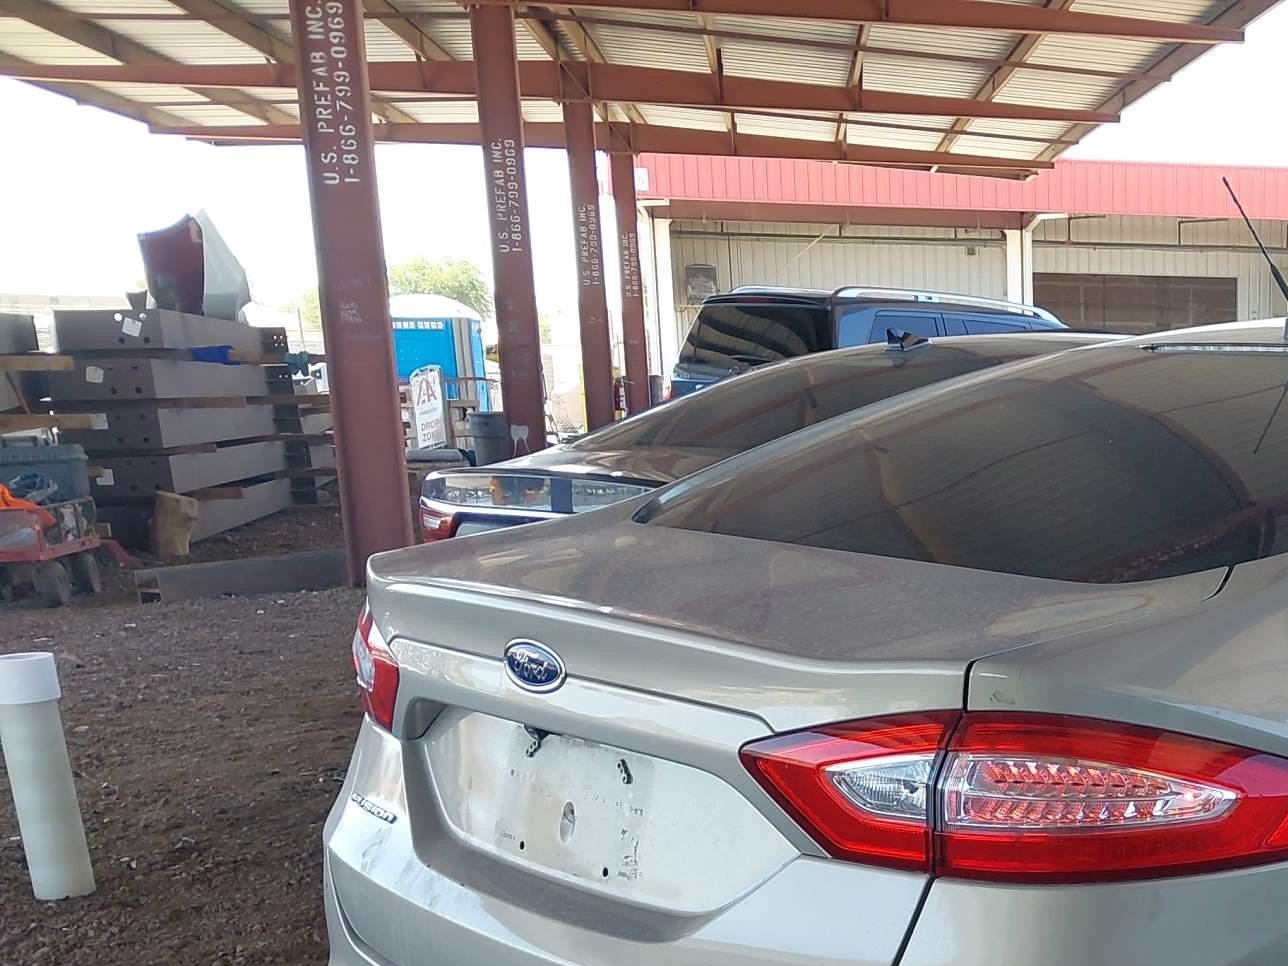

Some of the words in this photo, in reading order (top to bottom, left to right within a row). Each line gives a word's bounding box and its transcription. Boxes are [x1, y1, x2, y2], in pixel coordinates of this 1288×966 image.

[310, 51, 335, 133] PREFAB
[325, 2, 361, 183] 1-866-799-0969
[320, 146, 340, 185] U.S.
[493, 169, 507, 221] PREFAB
[508, 648, 550, 681] Ford
[351, 792, 398, 824] FUSION
